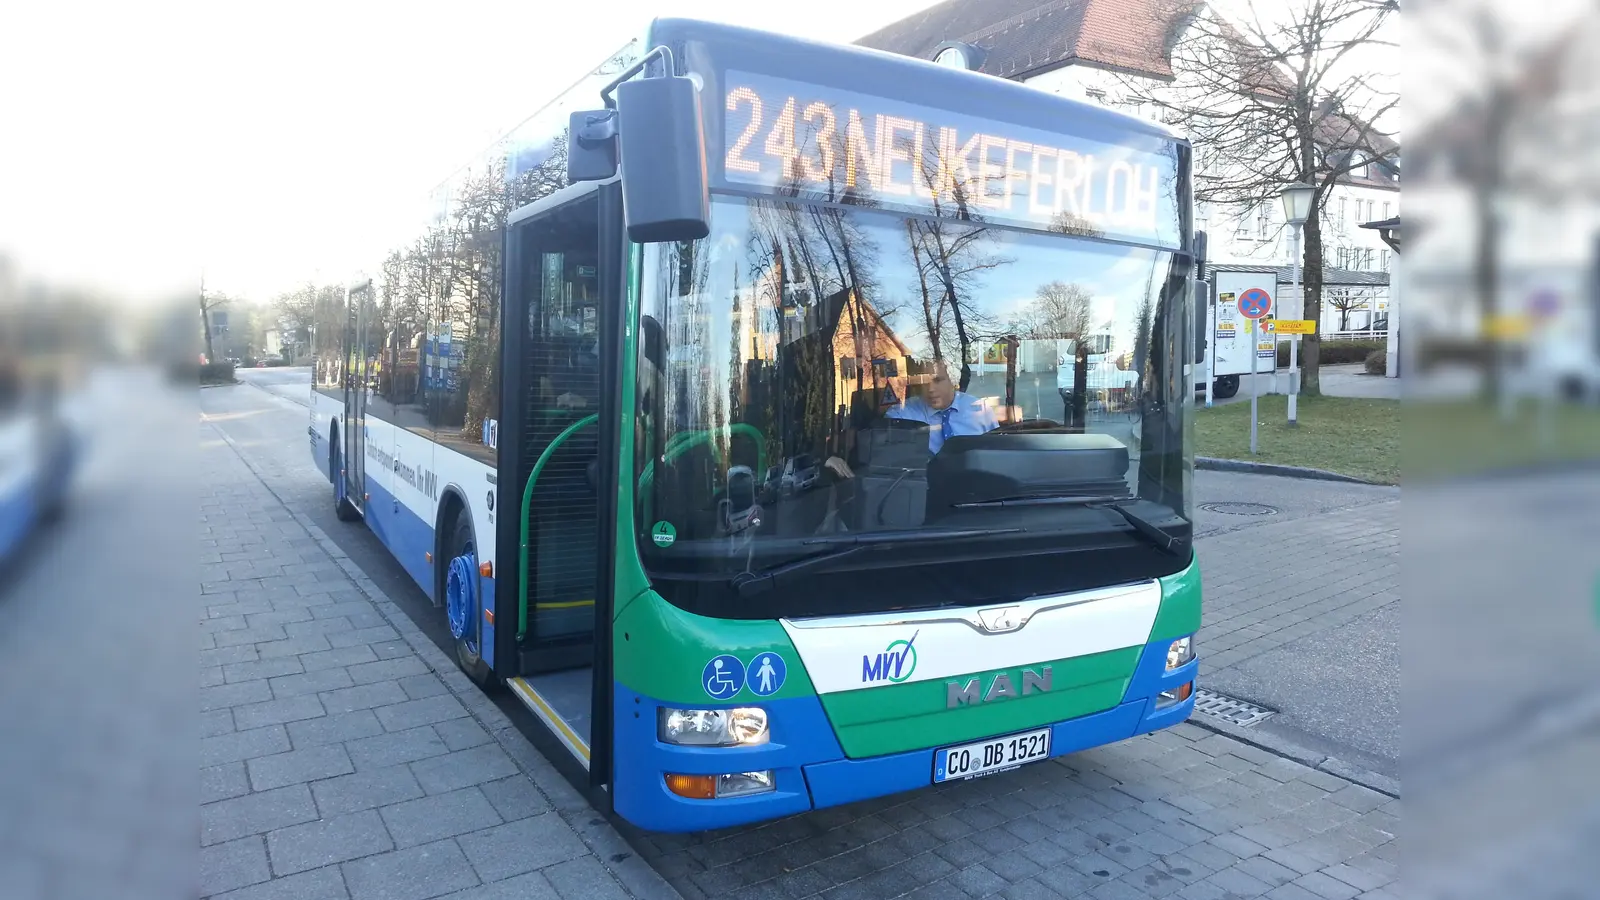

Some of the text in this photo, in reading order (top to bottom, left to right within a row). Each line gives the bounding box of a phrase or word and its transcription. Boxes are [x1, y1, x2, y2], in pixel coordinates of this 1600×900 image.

[724, 86, 1159, 226] 243 NEUKEFERLOH
[660, 522, 667, 534] 4
[862, 629, 920, 682] MVV
[945, 665, 1052, 709] MAN
[948, 733, 1046, 775] CO DB 1521
